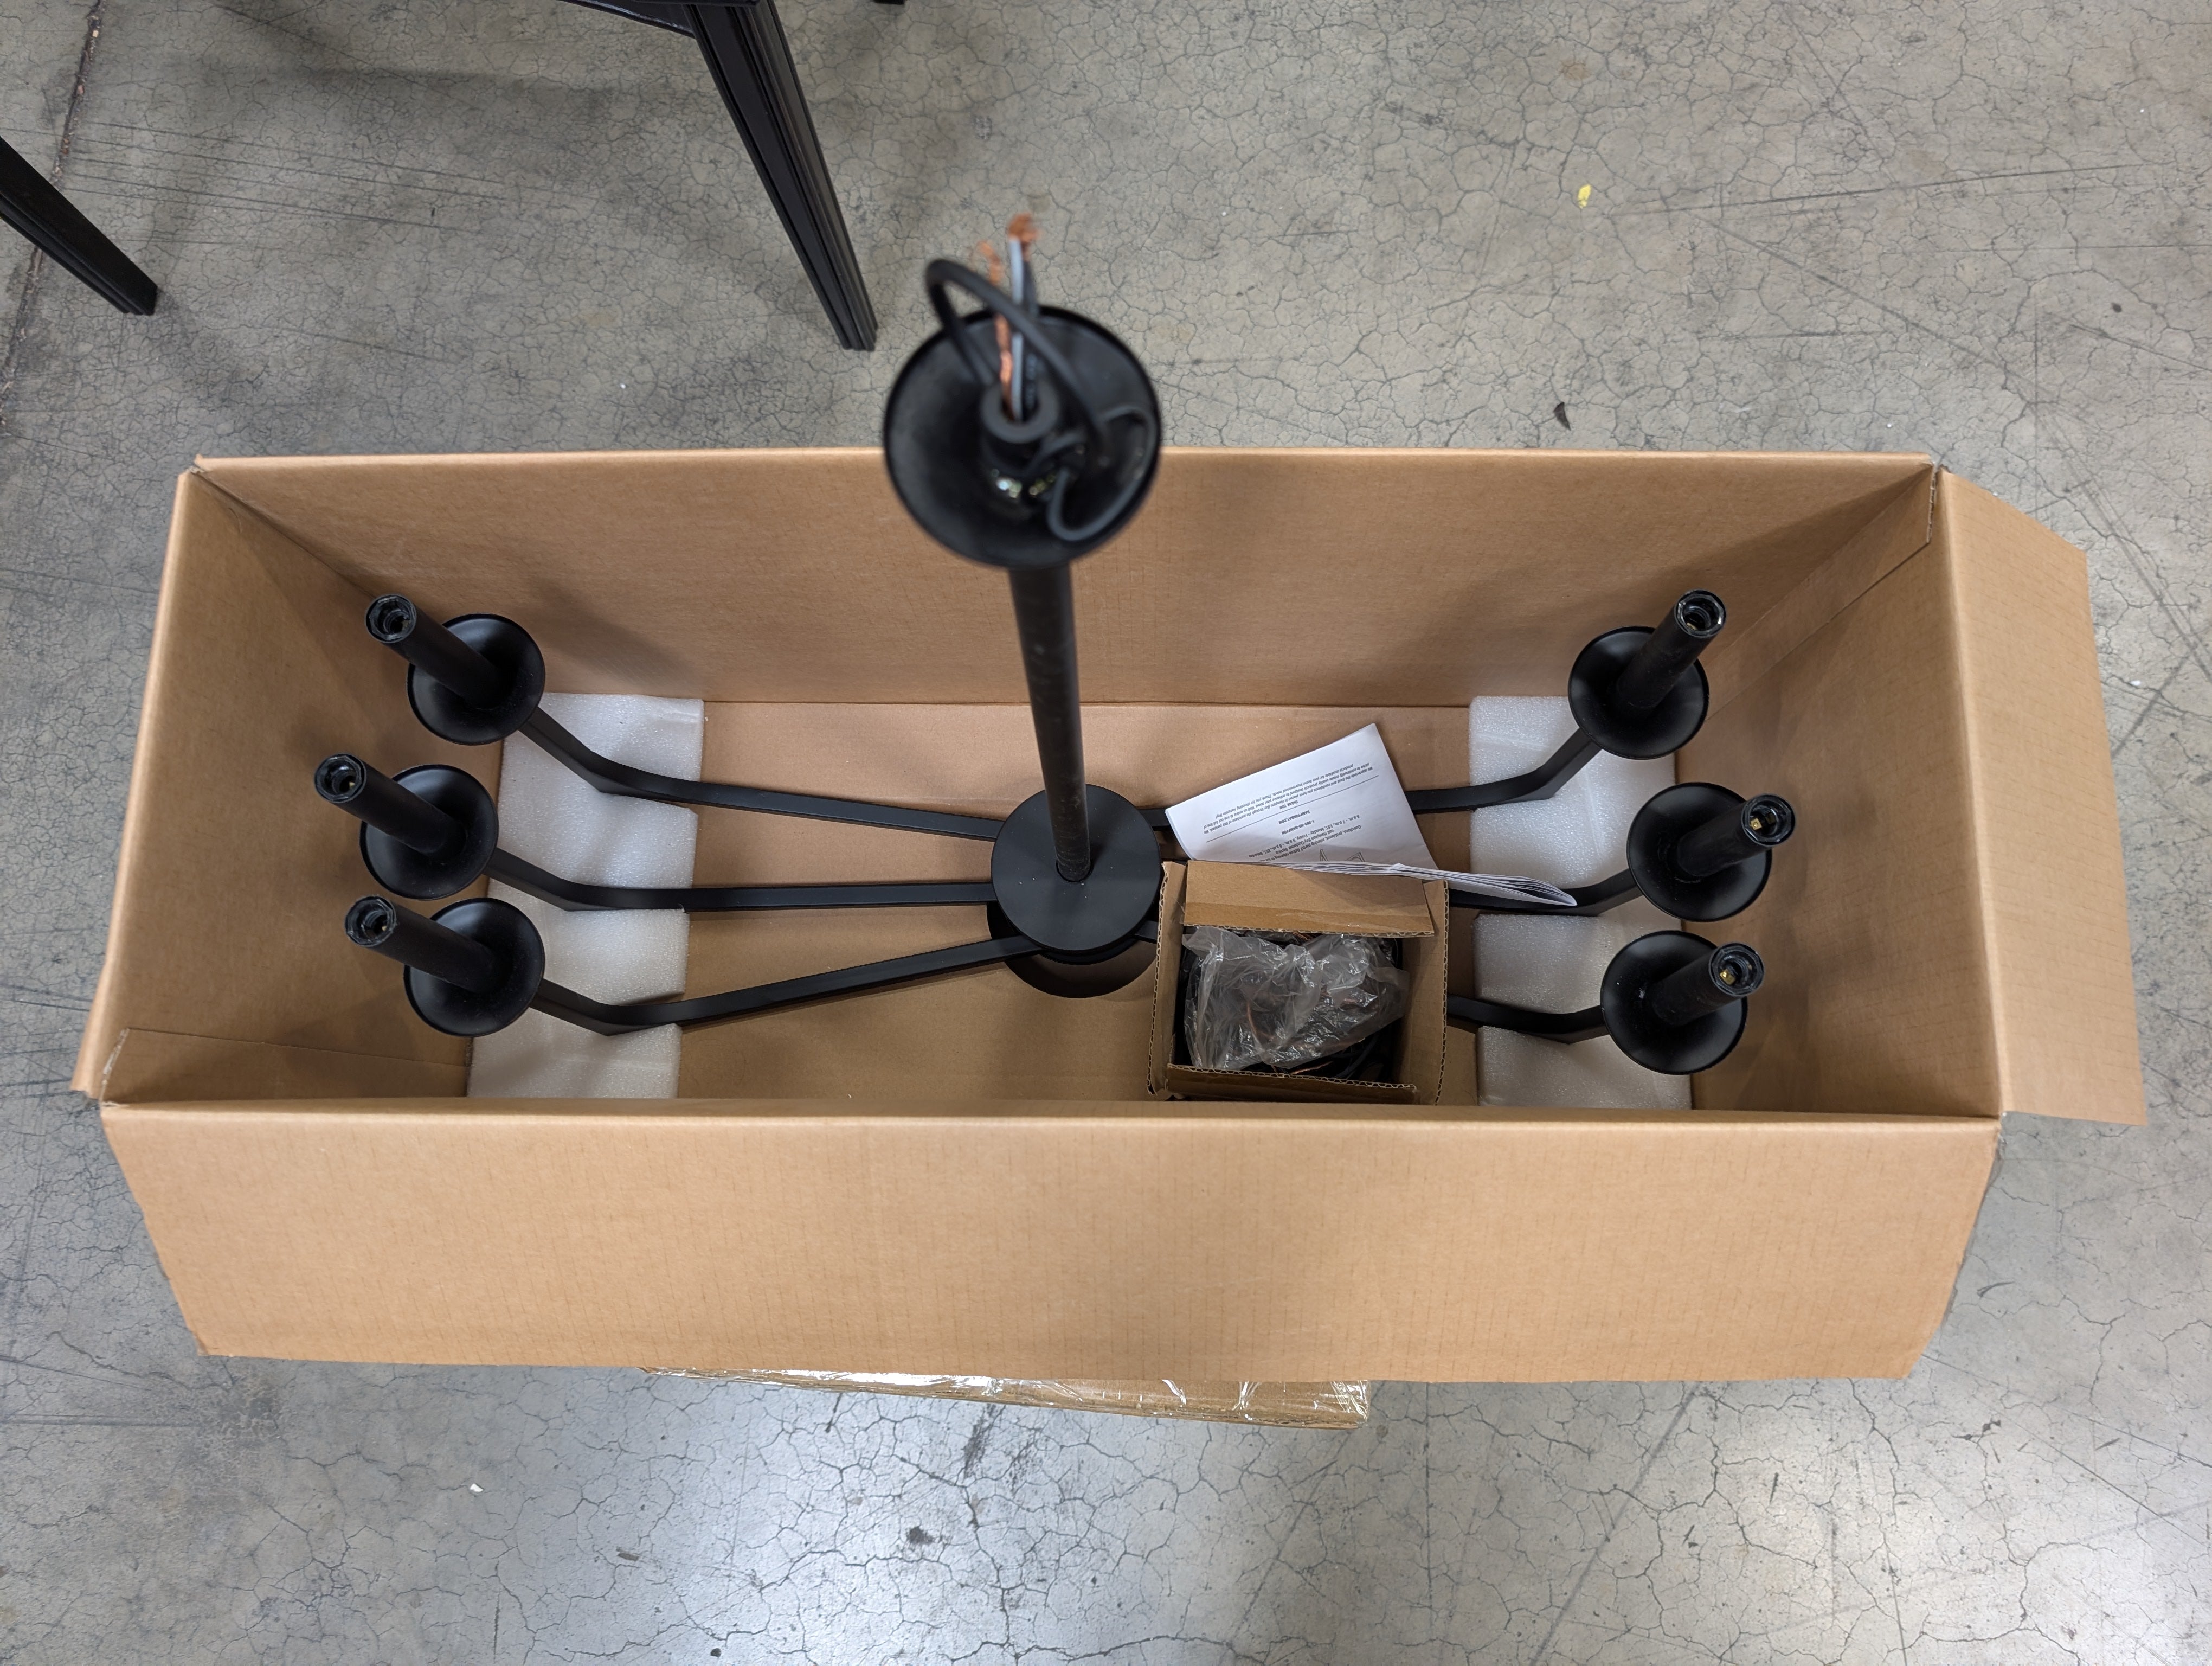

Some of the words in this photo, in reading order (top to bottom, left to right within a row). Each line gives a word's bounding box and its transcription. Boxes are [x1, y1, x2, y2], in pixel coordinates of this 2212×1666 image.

[1278, 810, 1310, 824] HAMPTONBAY.COM
[1281, 820, 1314, 834] 1-855-HD-HAMPTON
[1311, 831, 1327, 840] Hampton
[1288, 841, 1304, 849] Customer
[1300, 843, 1311, 851] parts?
